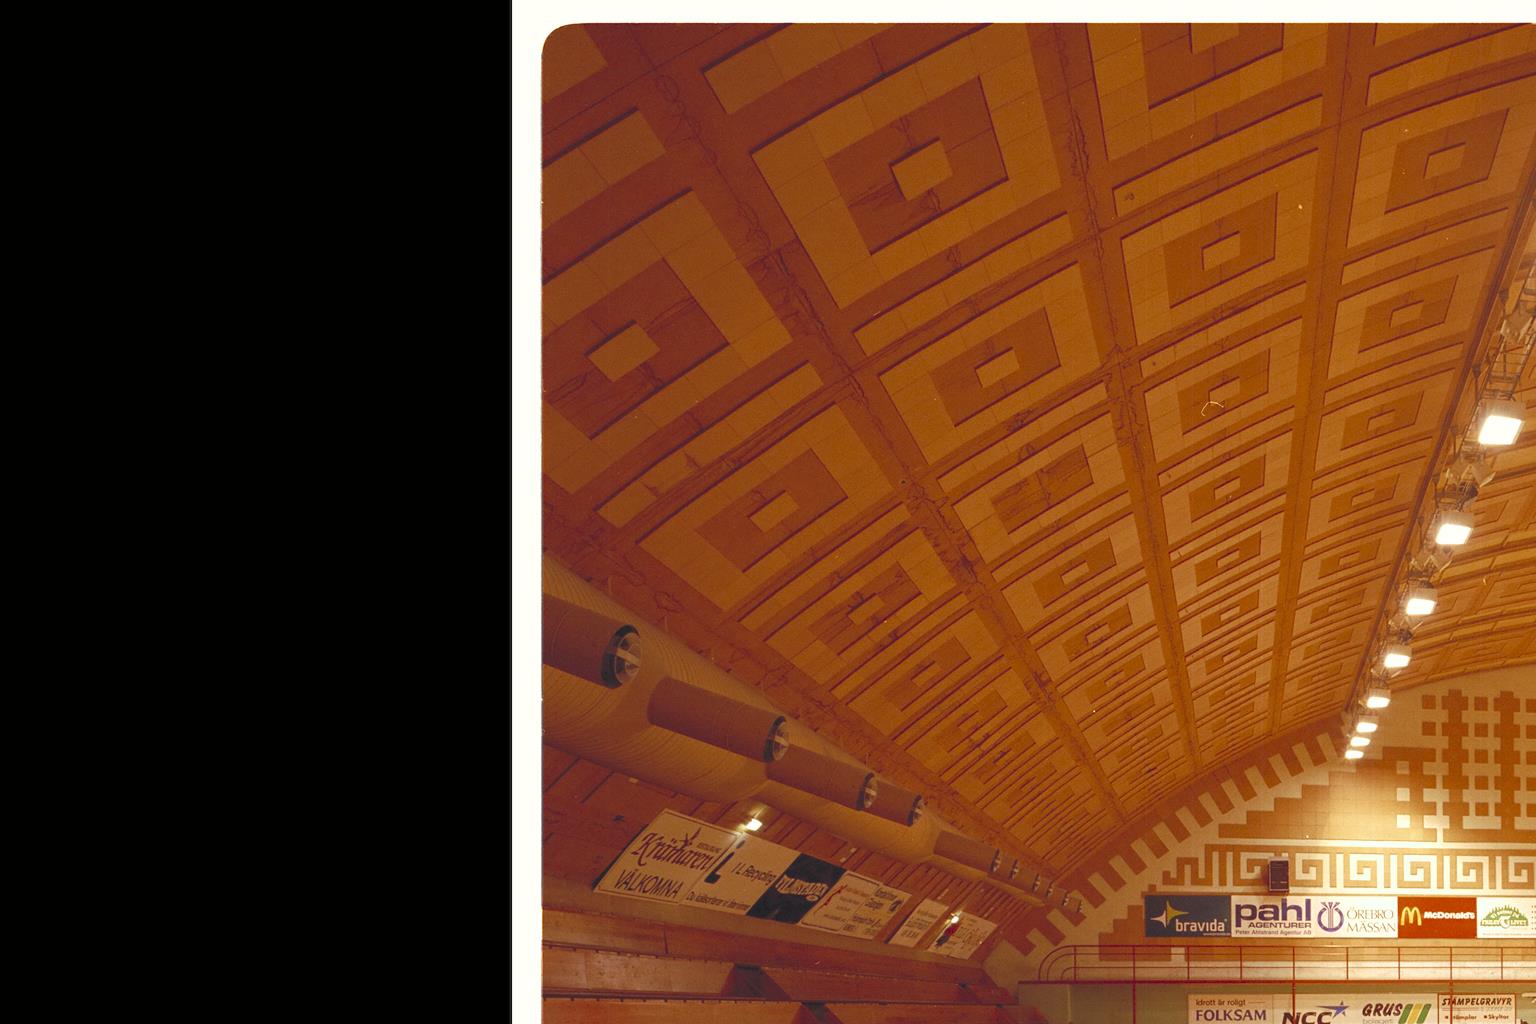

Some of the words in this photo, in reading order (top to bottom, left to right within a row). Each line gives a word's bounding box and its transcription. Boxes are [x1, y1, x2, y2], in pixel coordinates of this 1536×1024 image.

[614, 868, 685, 899] VÄLKOMNA
[1235, 898, 1311, 928] pahl
[1346, 905, 1394, 920] ÖREBRO
[1423, 911, 1476, 920] McDonald's
[1175, 918, 1225, 933] bravida
[1346, 919, 1396, 933] MÄSSAN
[1195, 1008, 1267, 1022] FOLKSAM
[1362, 1002, 1404, 1017] GRUS
